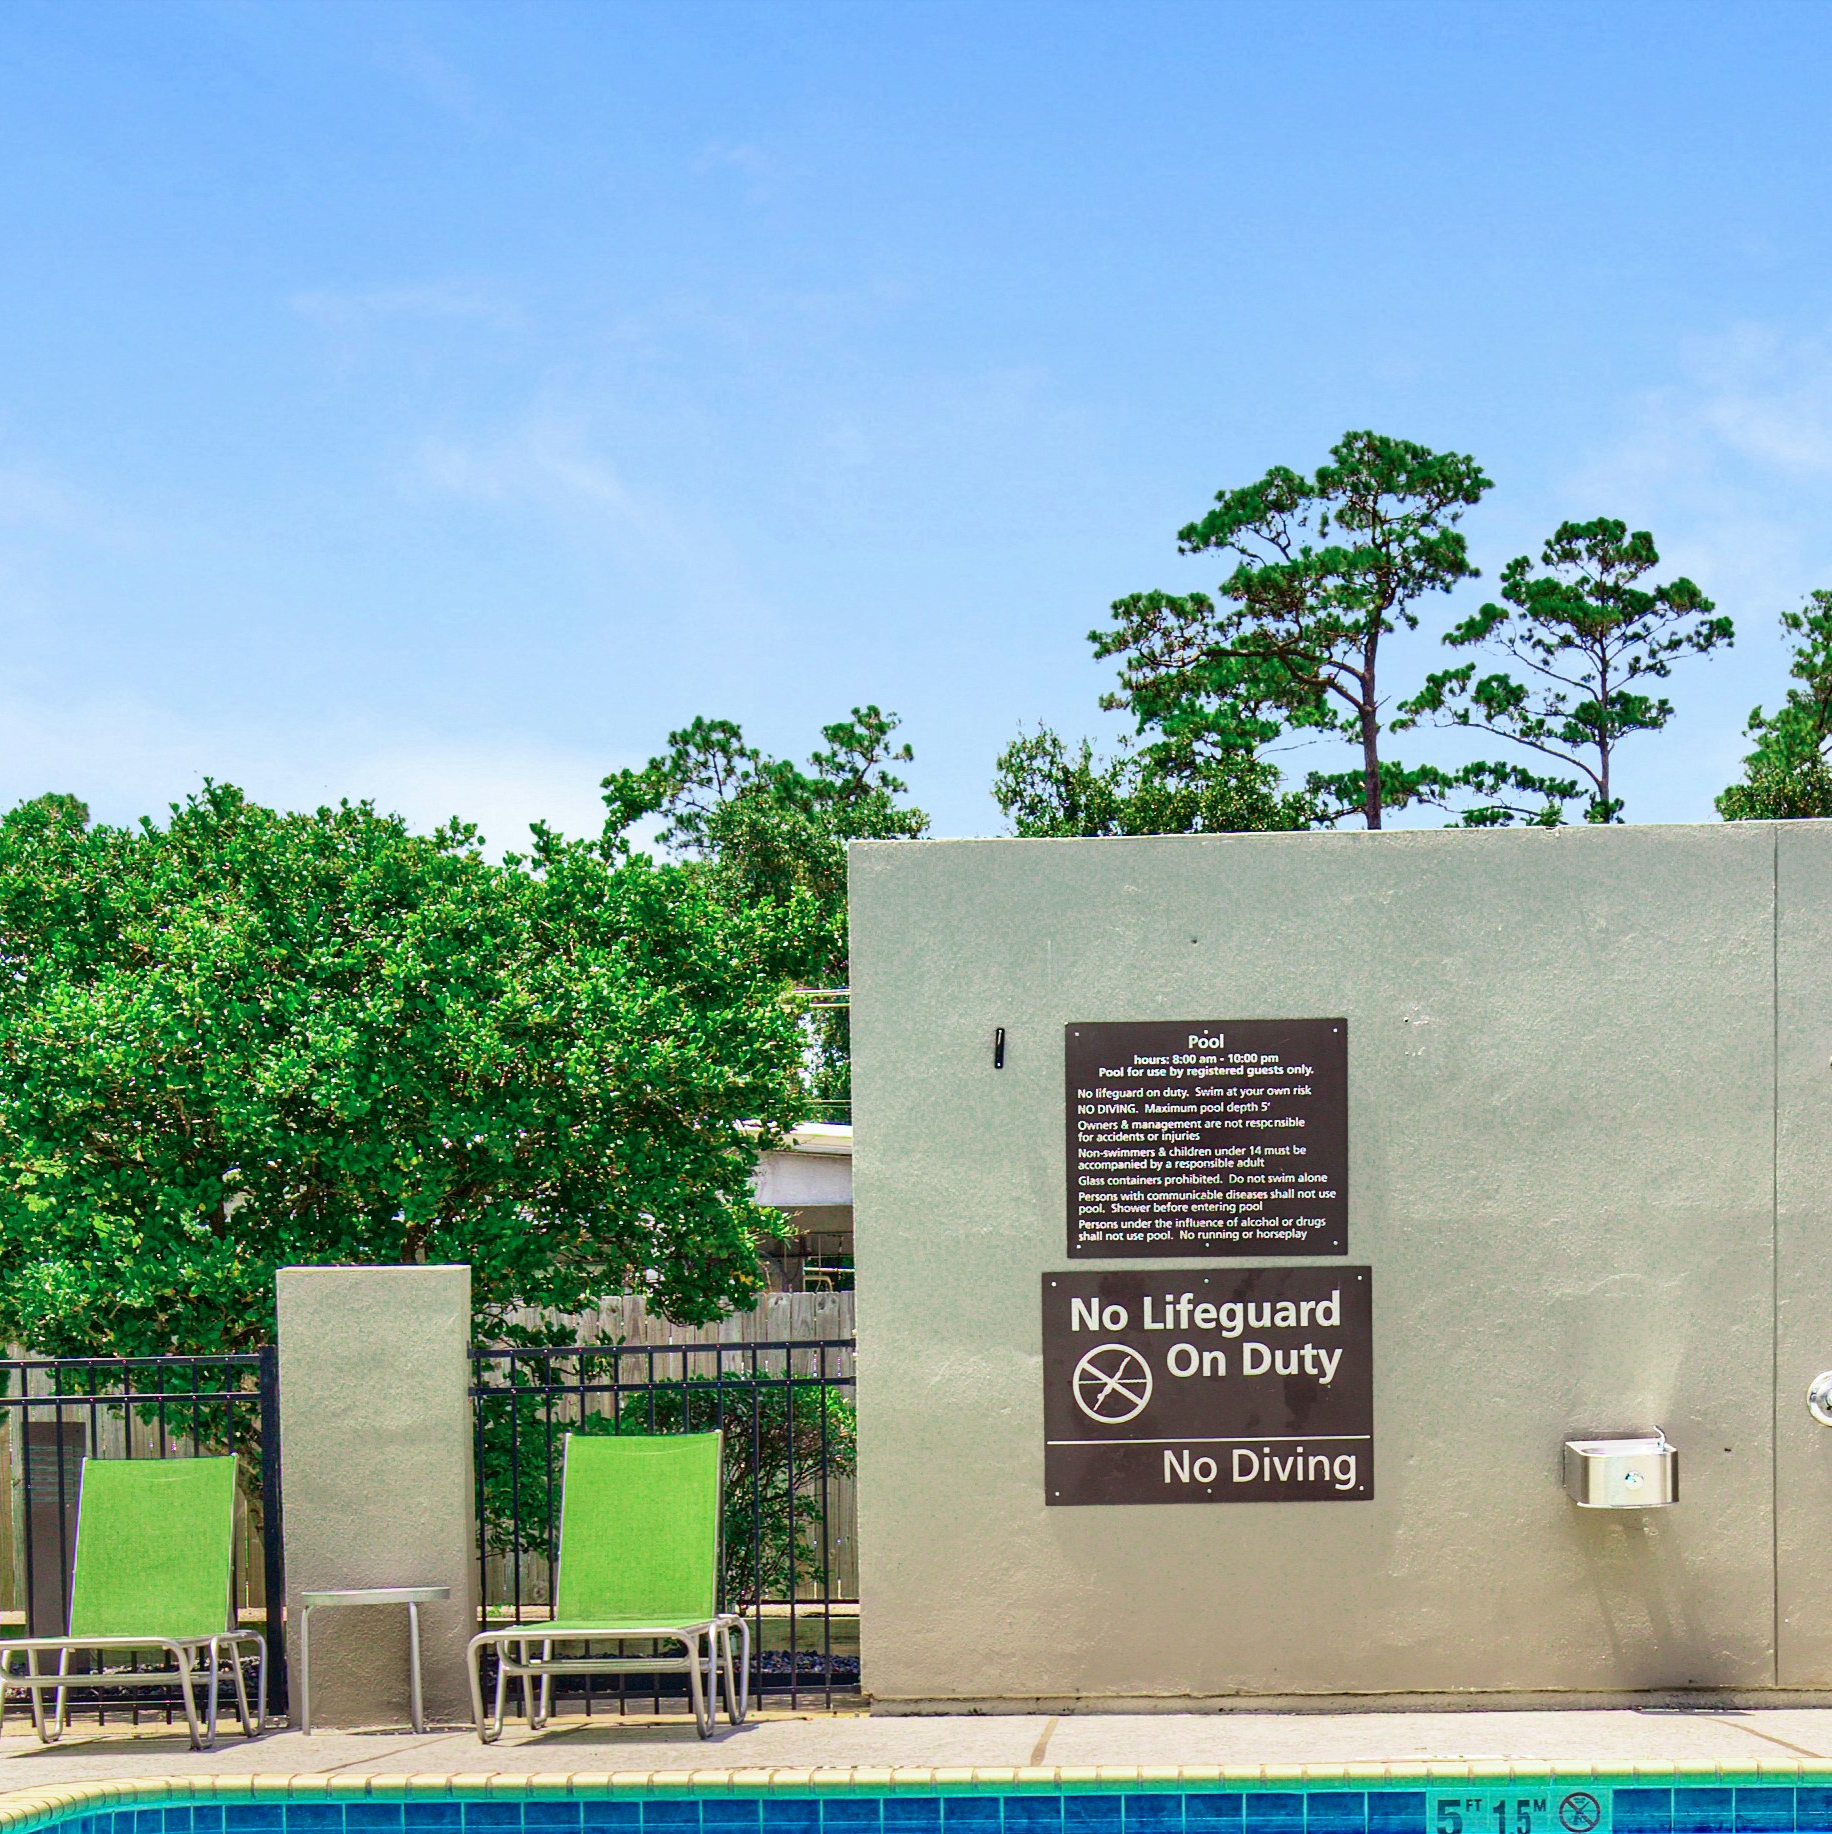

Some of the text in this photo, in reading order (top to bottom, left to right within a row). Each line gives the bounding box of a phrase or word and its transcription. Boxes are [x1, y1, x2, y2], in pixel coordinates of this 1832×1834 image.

[1189, 1034, 1224, 1048] Pool
[1134, 1055, 1169, 1065] hours:
[1172, 1054, 1196, 1064] 8:00
[1199, 1055, 1217, 1064] am
[1228, 1053, 1258, 1063] 10:00
[1261, 1055, 1279, 1065] pm
[1099, 1064, 1314, 1078] Pool for use by registered guests only.
[1078, 1085, 1312, 1100] No lifeguard on duty. Swim at your own risk
[1078, 1104, 1095, 1115] NO
[1098, 1104, 1139, 1114] DIVING.
[1145, 1103, 1197, 1114] Maximum
[1200, 1102, 1224, 1115] pool
[1227, 1102, 1258, 1114] depth
[1078, 1120, 1118, 1130] Owners
[1121, 1120, 1129, 1130] &
[1132, 1120, 1202, 1132] management
[1204, 1119, 1222, 1129] are
[1224, 1119, 1243, 1129] not
[1078, 1131, 1201, 1143] for accidents or injuries
[1078, 1145, 1307, 1158] Non-swimmers & children under 14 must be
[1078, 1157, 1265, 1172] accompanied by a responsible adult
[1078, 1172, 1328, 1188] Glass containers prohibited. Do not swim alone
[1078, 1188, 1337, 1202] Persons with communicable diseases shall not use
[1078, 1201, 1263, 1215] pool. Shower before entering pool
[1078, 1216, 1327, 1230] Persons under the influence of alcohol or drugs
[1078, 1228, 1308, 1242] shall not use pool. No running or horseplay
[1071, 1289, 1341, 1338] No Lifeguard
[1167, 1342, 1343, 1385] On Duty
[1163, 1446, 1357, 1491] No Diving
